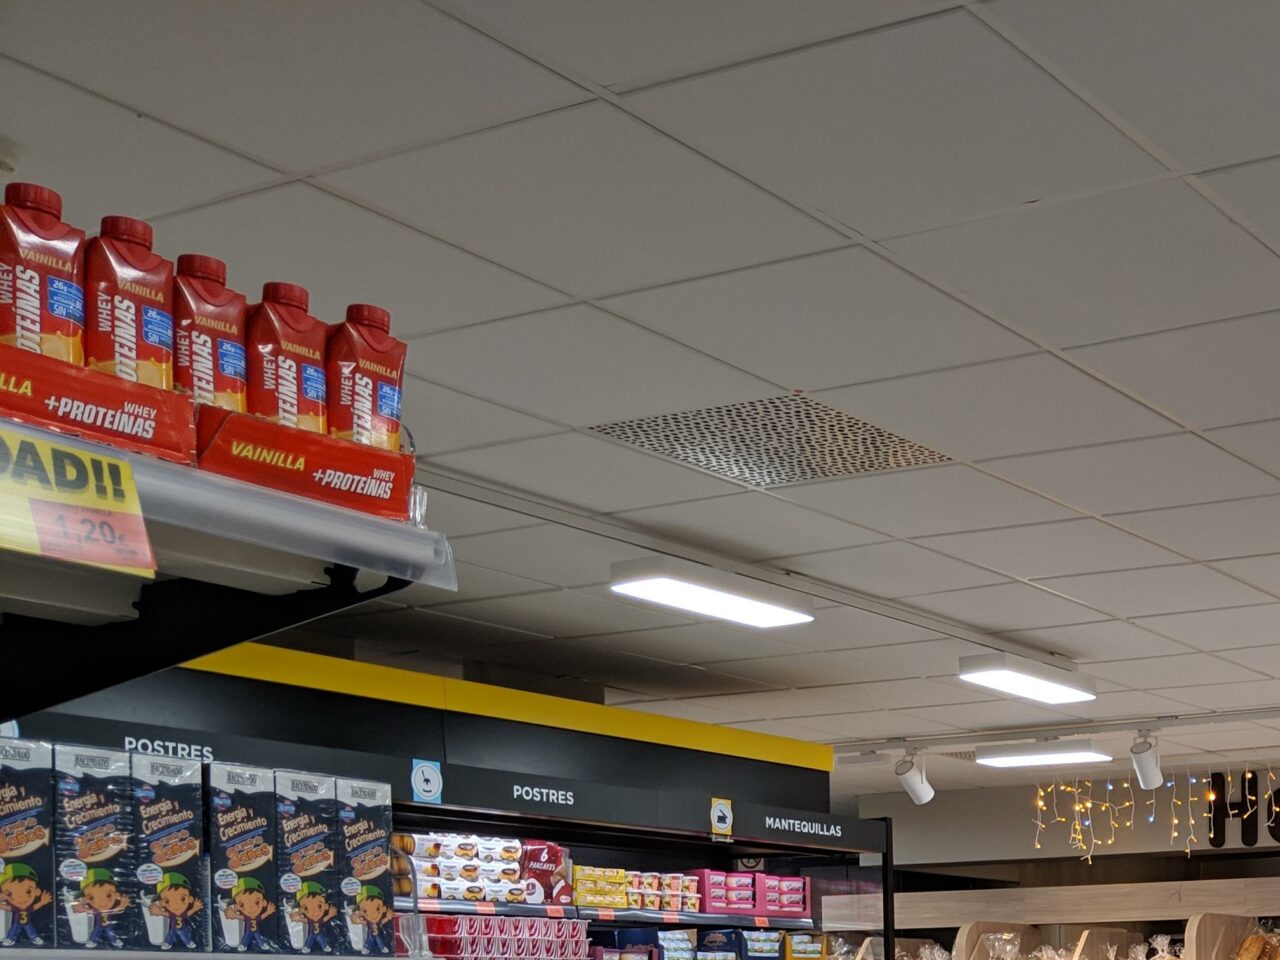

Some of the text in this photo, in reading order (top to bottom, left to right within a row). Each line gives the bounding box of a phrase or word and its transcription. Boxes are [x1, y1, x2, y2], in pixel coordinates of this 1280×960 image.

[20, 249, 73, 273] VAINILLA
[0, 261, 13, 304] WHEY
[118, 280, 165, 303] VAINILLA
[97, 292, 112, 332] WHEY
[194, 314, 238, 335] VAINILLA
[176, 328, 190, 366] WHEY
[280, 340, 321, 361] VAINILLA
[263, 352, 276, 390] WHEY
[358, 358, 398, 379] VAINILLA
[340, 367, 353, 405] WHEY
[44, 395, 156, 440] +PROTEÍNAS
[124, 401, 158, 420] WHEY
[230, 440, 305, 472] VAINILLA
[312, 468, 394, 500] +PROTEÍNAS
[373, 468, 395, 482] WHEY
[124, 736, 214, 763] POSTRES
[513, 785, 575, 805] POSTRES
[139, 799, 174, 819] Energía
[217, 806, 248, 826] Energía
[141, 810, 194, 835] Crecimiento
[219, 818, 268, 842] Crecimiento
[765, 816, 842, 838] MANTEQUILLAS
[541, 848, 549, 862] 6
